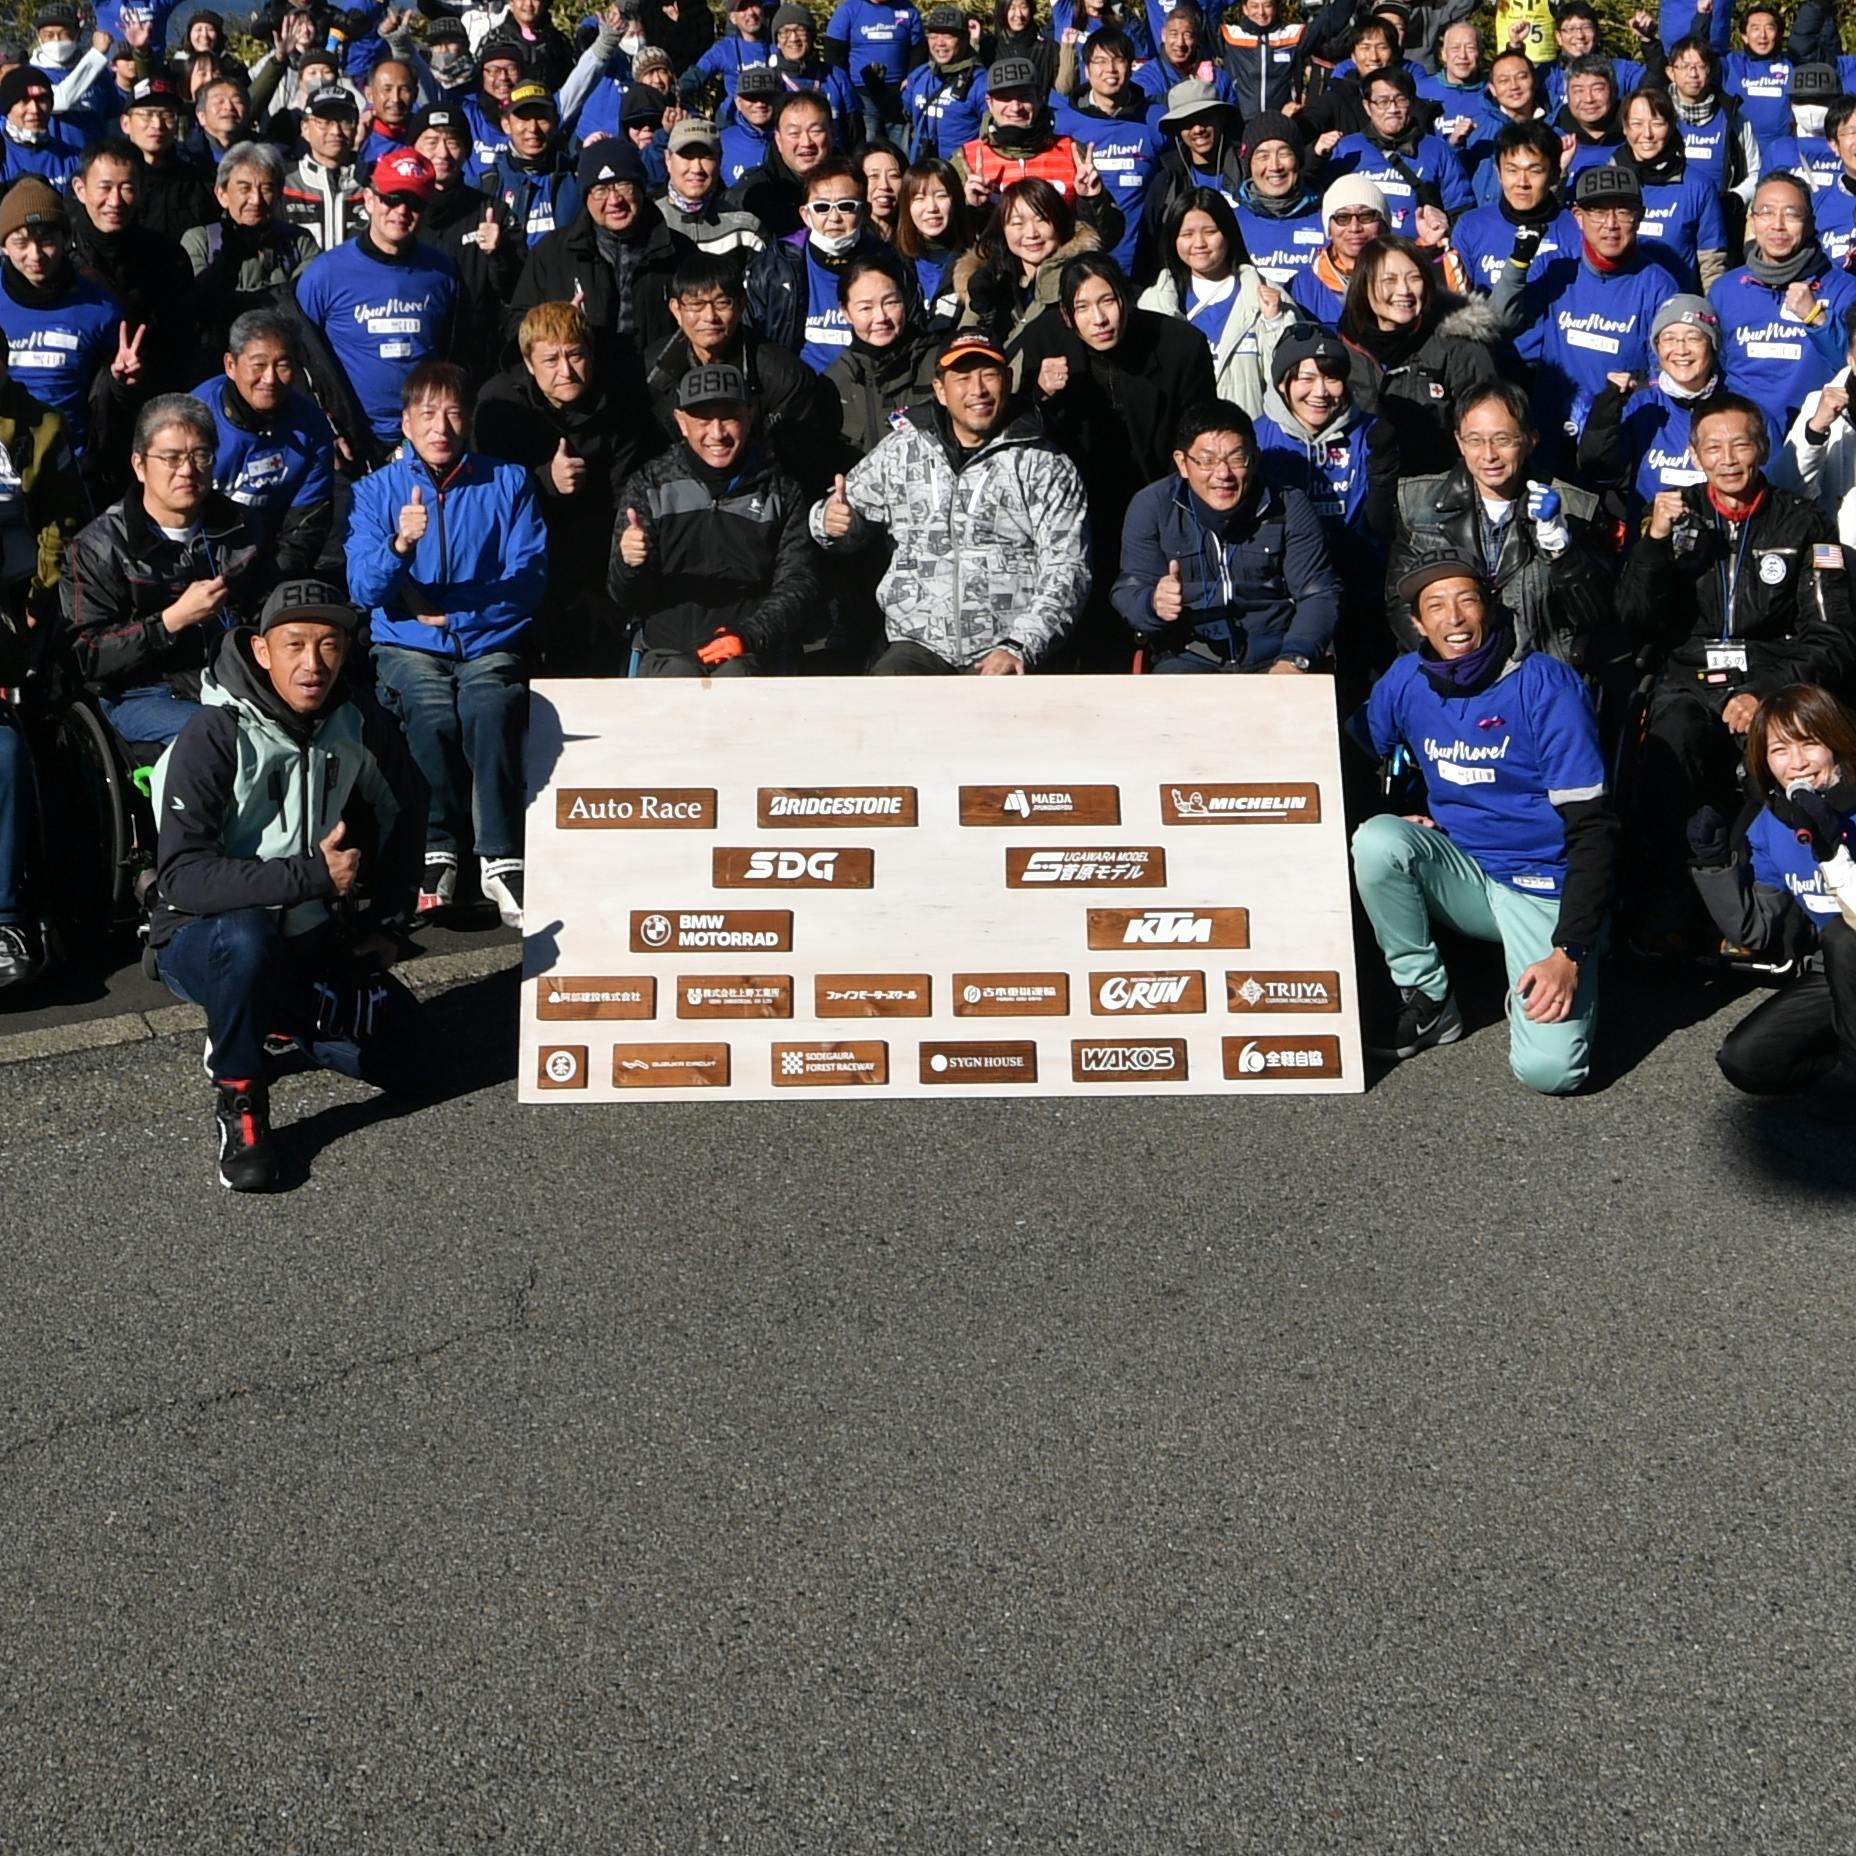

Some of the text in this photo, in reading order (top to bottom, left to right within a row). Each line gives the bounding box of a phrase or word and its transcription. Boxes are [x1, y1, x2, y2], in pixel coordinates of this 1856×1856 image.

[993, 63, 1031, 83] SSP
[1793, 71, 1831, 89] SSP
[1583, 170, 1632, 194] SSP
[687, 370, 739, 395] SSP
[568, 795, 702, 820] Auto Race
[768, 796, 902, 816] BRIDGESTONE
[1031, 793, 1072, 805] MAEDA
[1208, 796, 1307, 810] MICHELIN
[1117, 851, 1149, 862] MODEL
[744, 851, 839, 882] SDG
[1059, 863, 1144, 882] 菅原モデル
[679, 915, 725, 930] BMW
[1123, 912, 1212, 944] KTM
[678, 932, 779, 947] MOTORRAD
[1265, 982, 1328, 998] TRIJYA
[805, 1051, 855, 1062] SODEGAURA
[949, 1056, 1024, 1068] SYGN HOUSE
[805, 1062, 875, 1073] FOREST RACEWAY
